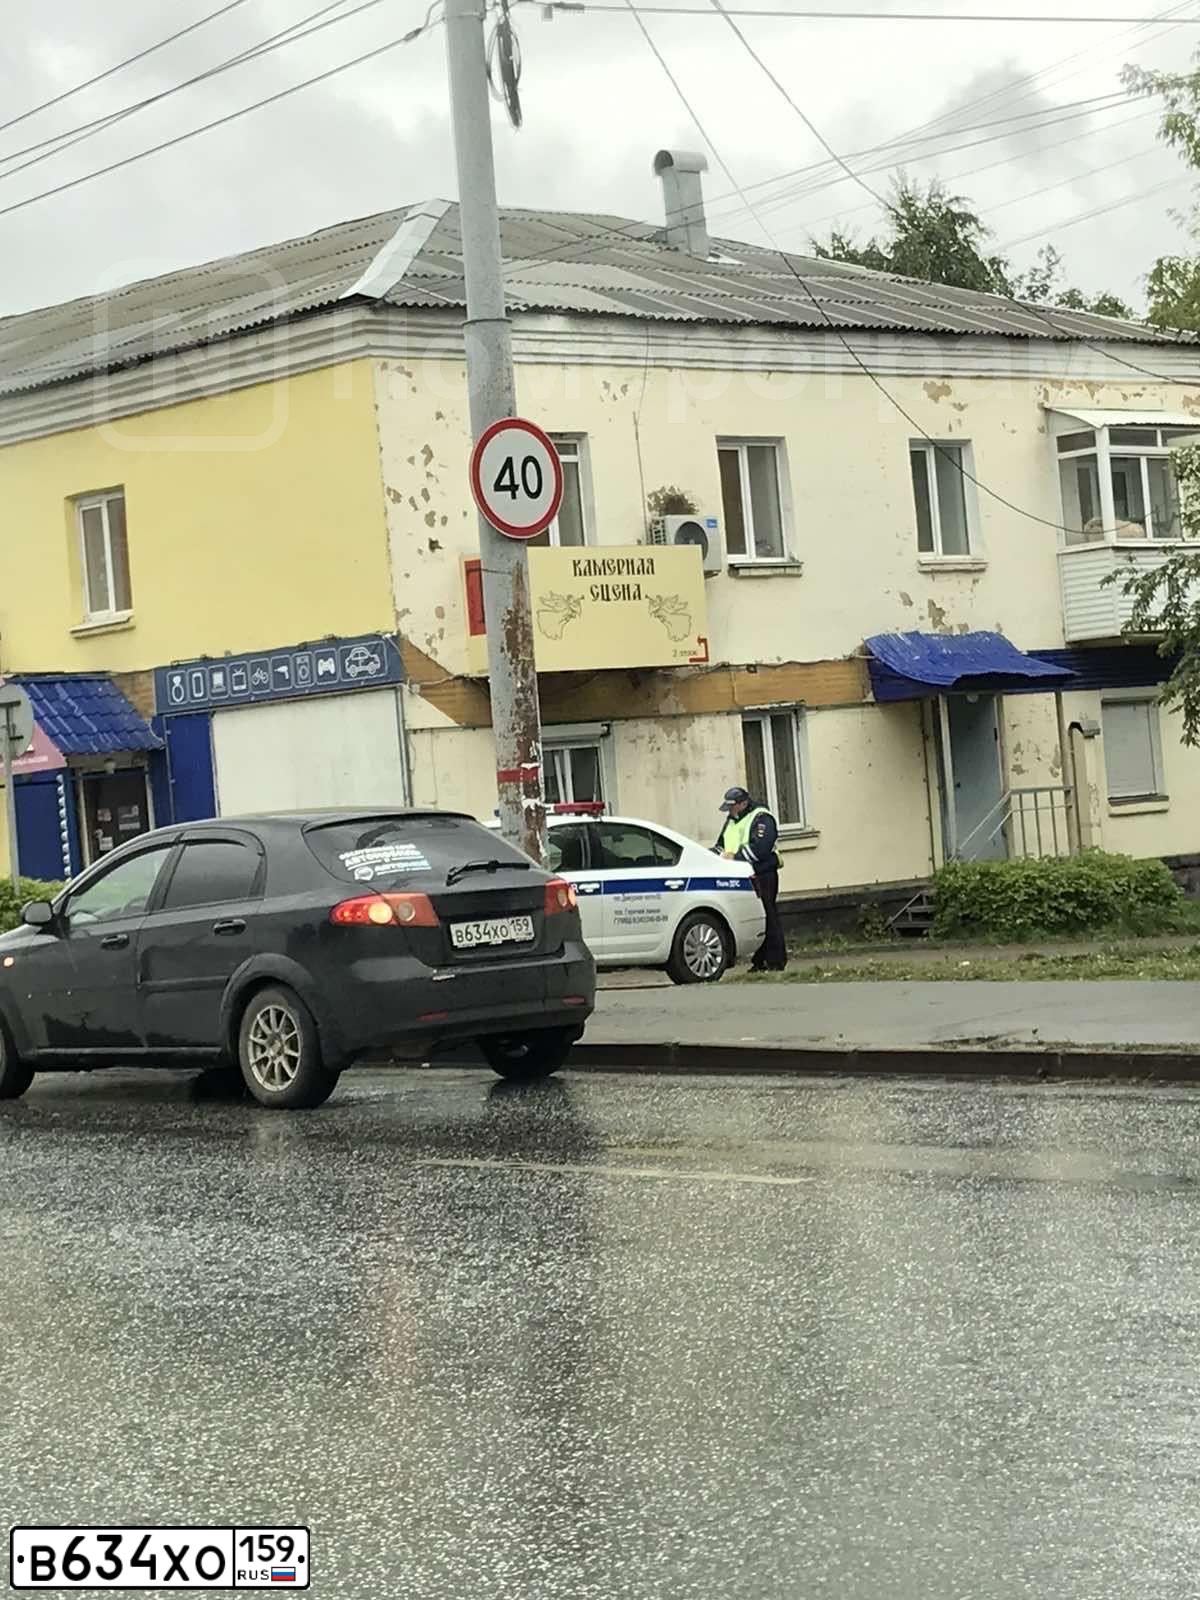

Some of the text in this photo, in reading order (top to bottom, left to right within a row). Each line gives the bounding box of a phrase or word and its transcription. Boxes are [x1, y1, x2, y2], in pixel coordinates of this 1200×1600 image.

[493, 455, 543, 500] 40
[572, 558, 655, 577] КАМЕРНАЯ
[590, 583, 641, 602] СЦЕНА
[510, 918, 529, 932] 159
